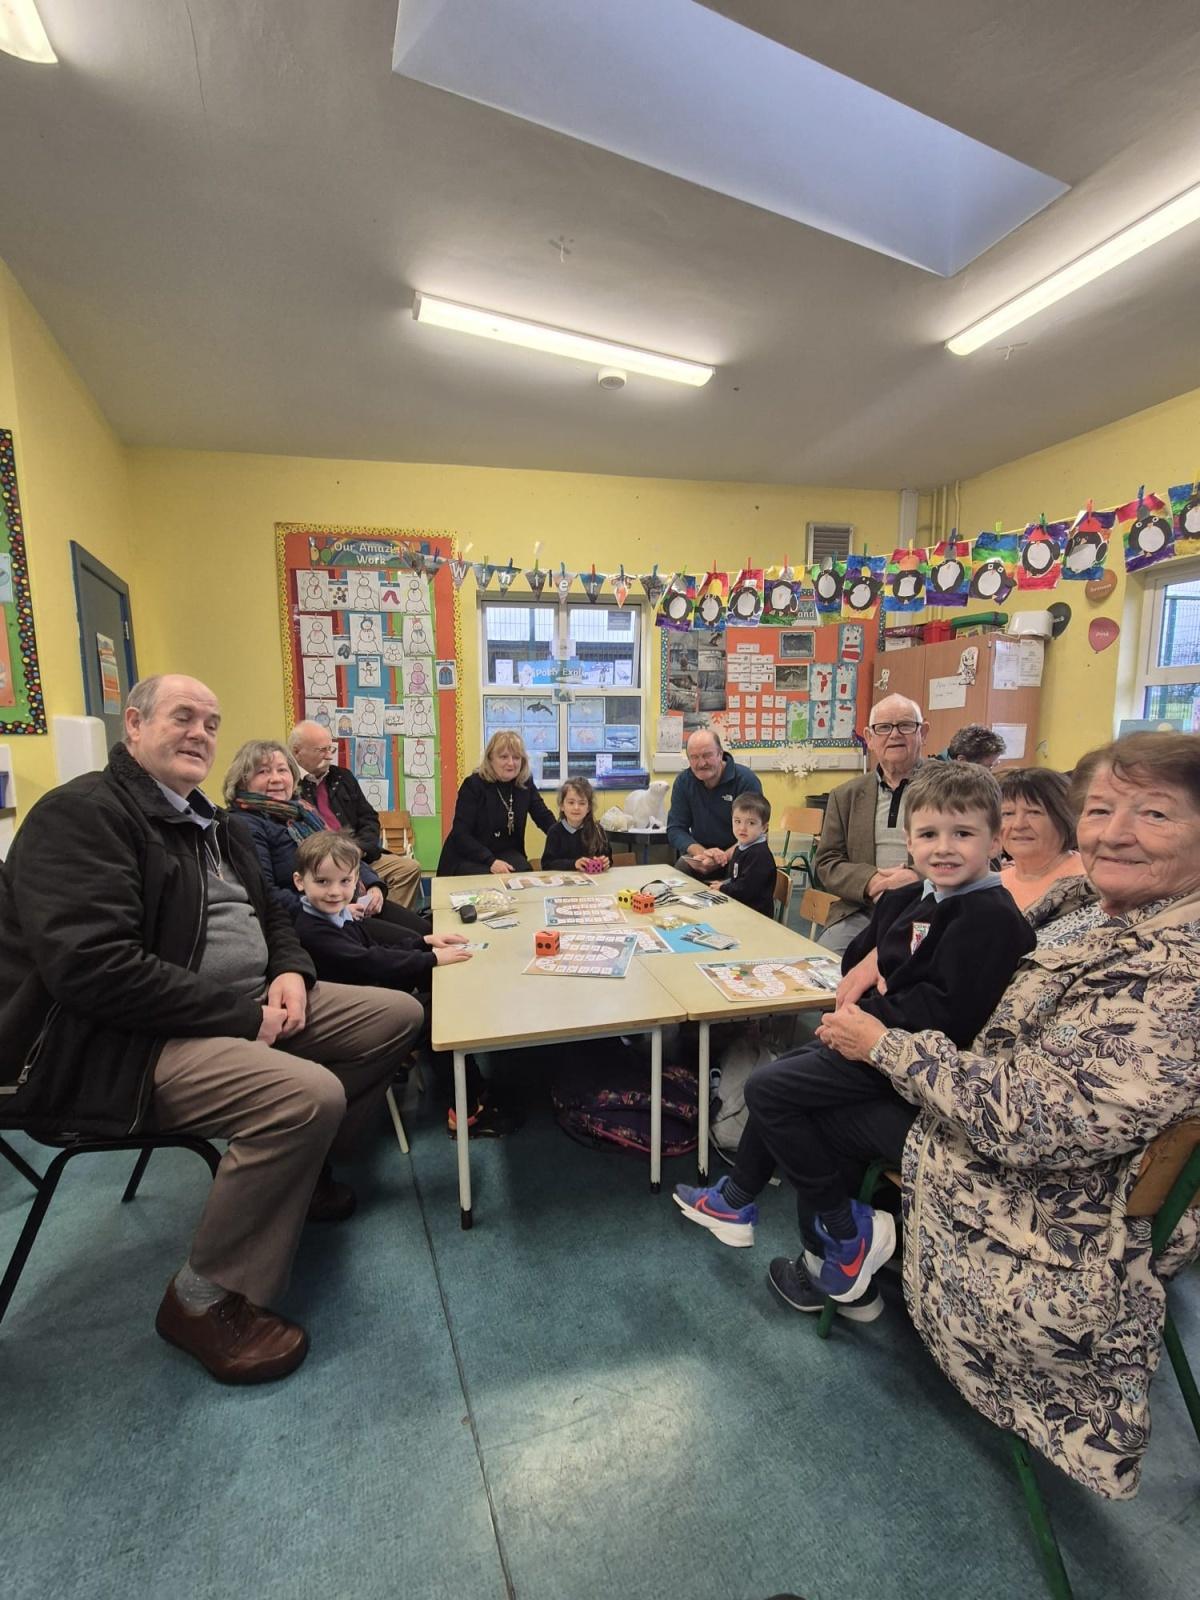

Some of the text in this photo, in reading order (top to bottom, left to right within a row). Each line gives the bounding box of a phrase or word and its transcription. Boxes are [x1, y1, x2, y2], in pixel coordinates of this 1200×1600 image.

[334, 542, 354, 552] Our
[356, 554, 386, 565] Work
[797, 609, 815, 618] and
